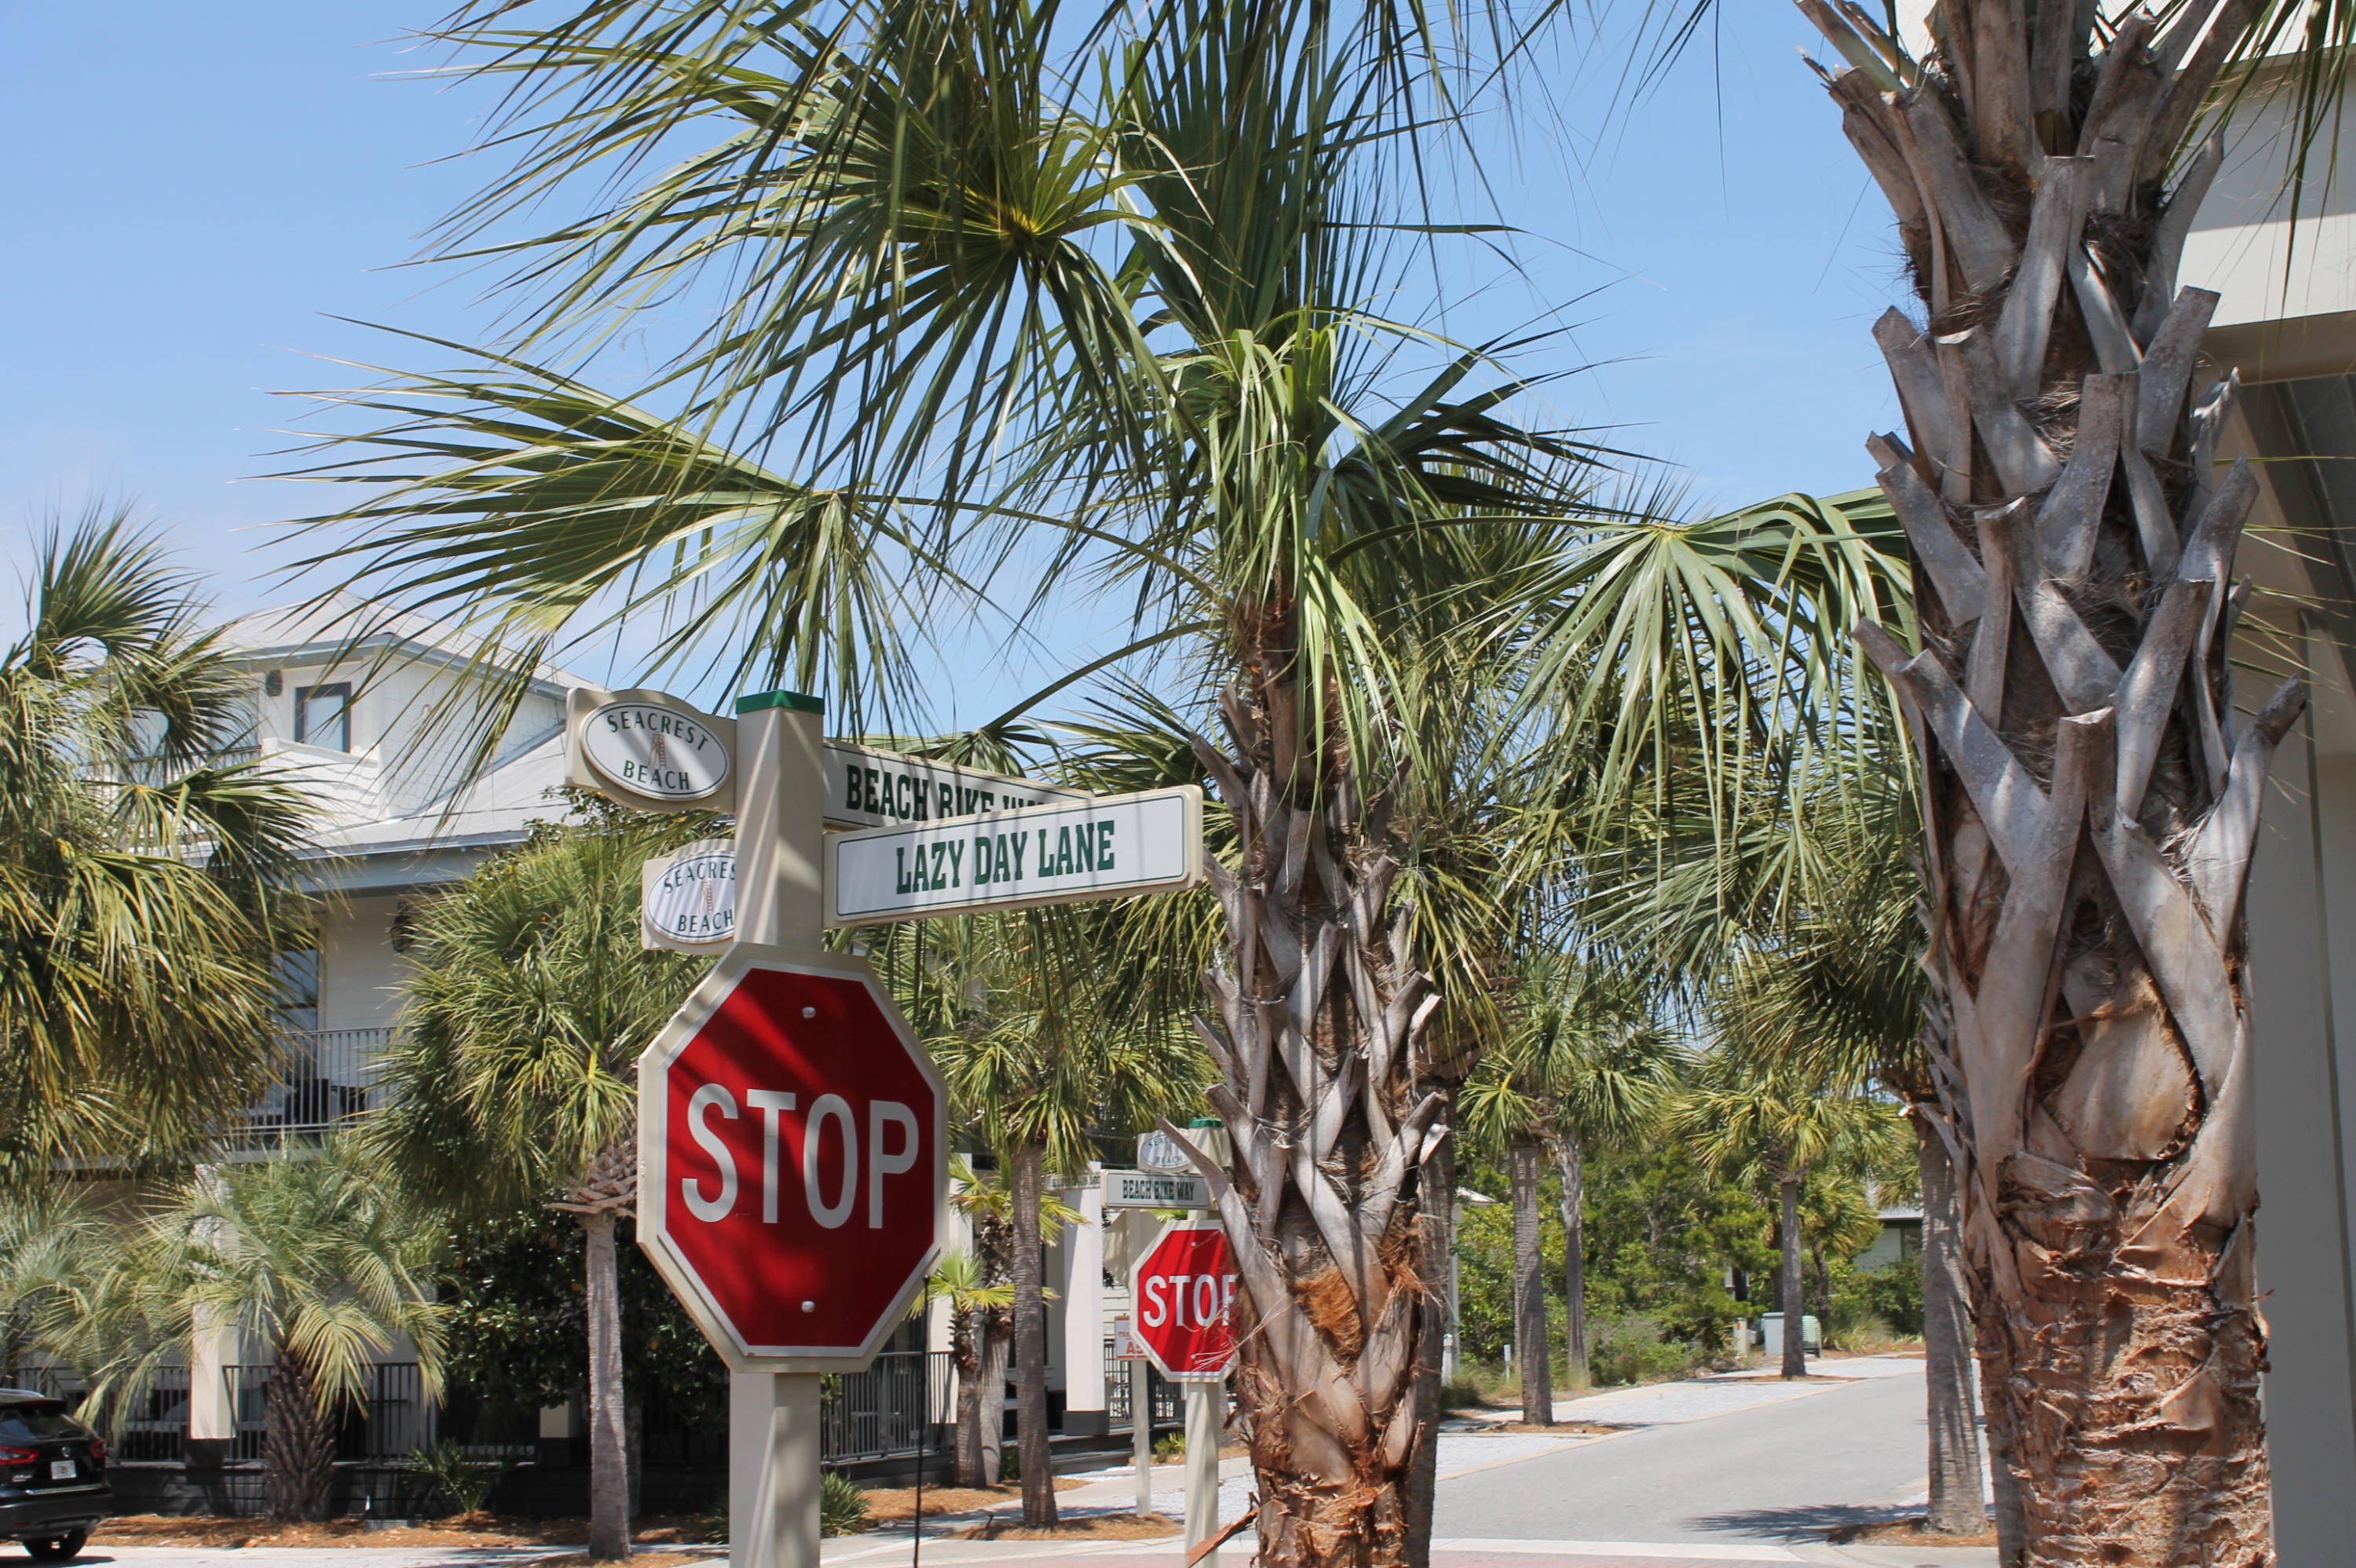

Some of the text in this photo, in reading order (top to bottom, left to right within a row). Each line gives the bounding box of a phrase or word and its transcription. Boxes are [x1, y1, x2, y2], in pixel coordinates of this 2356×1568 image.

[607, 711, 709, 751] SEACREST
[624, 759, 690, 790] BEACH
[846, 765, 929, 821] BEACH
[897, 820, 1115, 895] LAZY DAY LANE
[664, 861, 735, 894] SEACRES
[678, 909, 734, 932] BEACH
[682, 1083, 920, 1230] STOP
[1123, 1180, 1194, 1201] BEACH BIKE WAY
